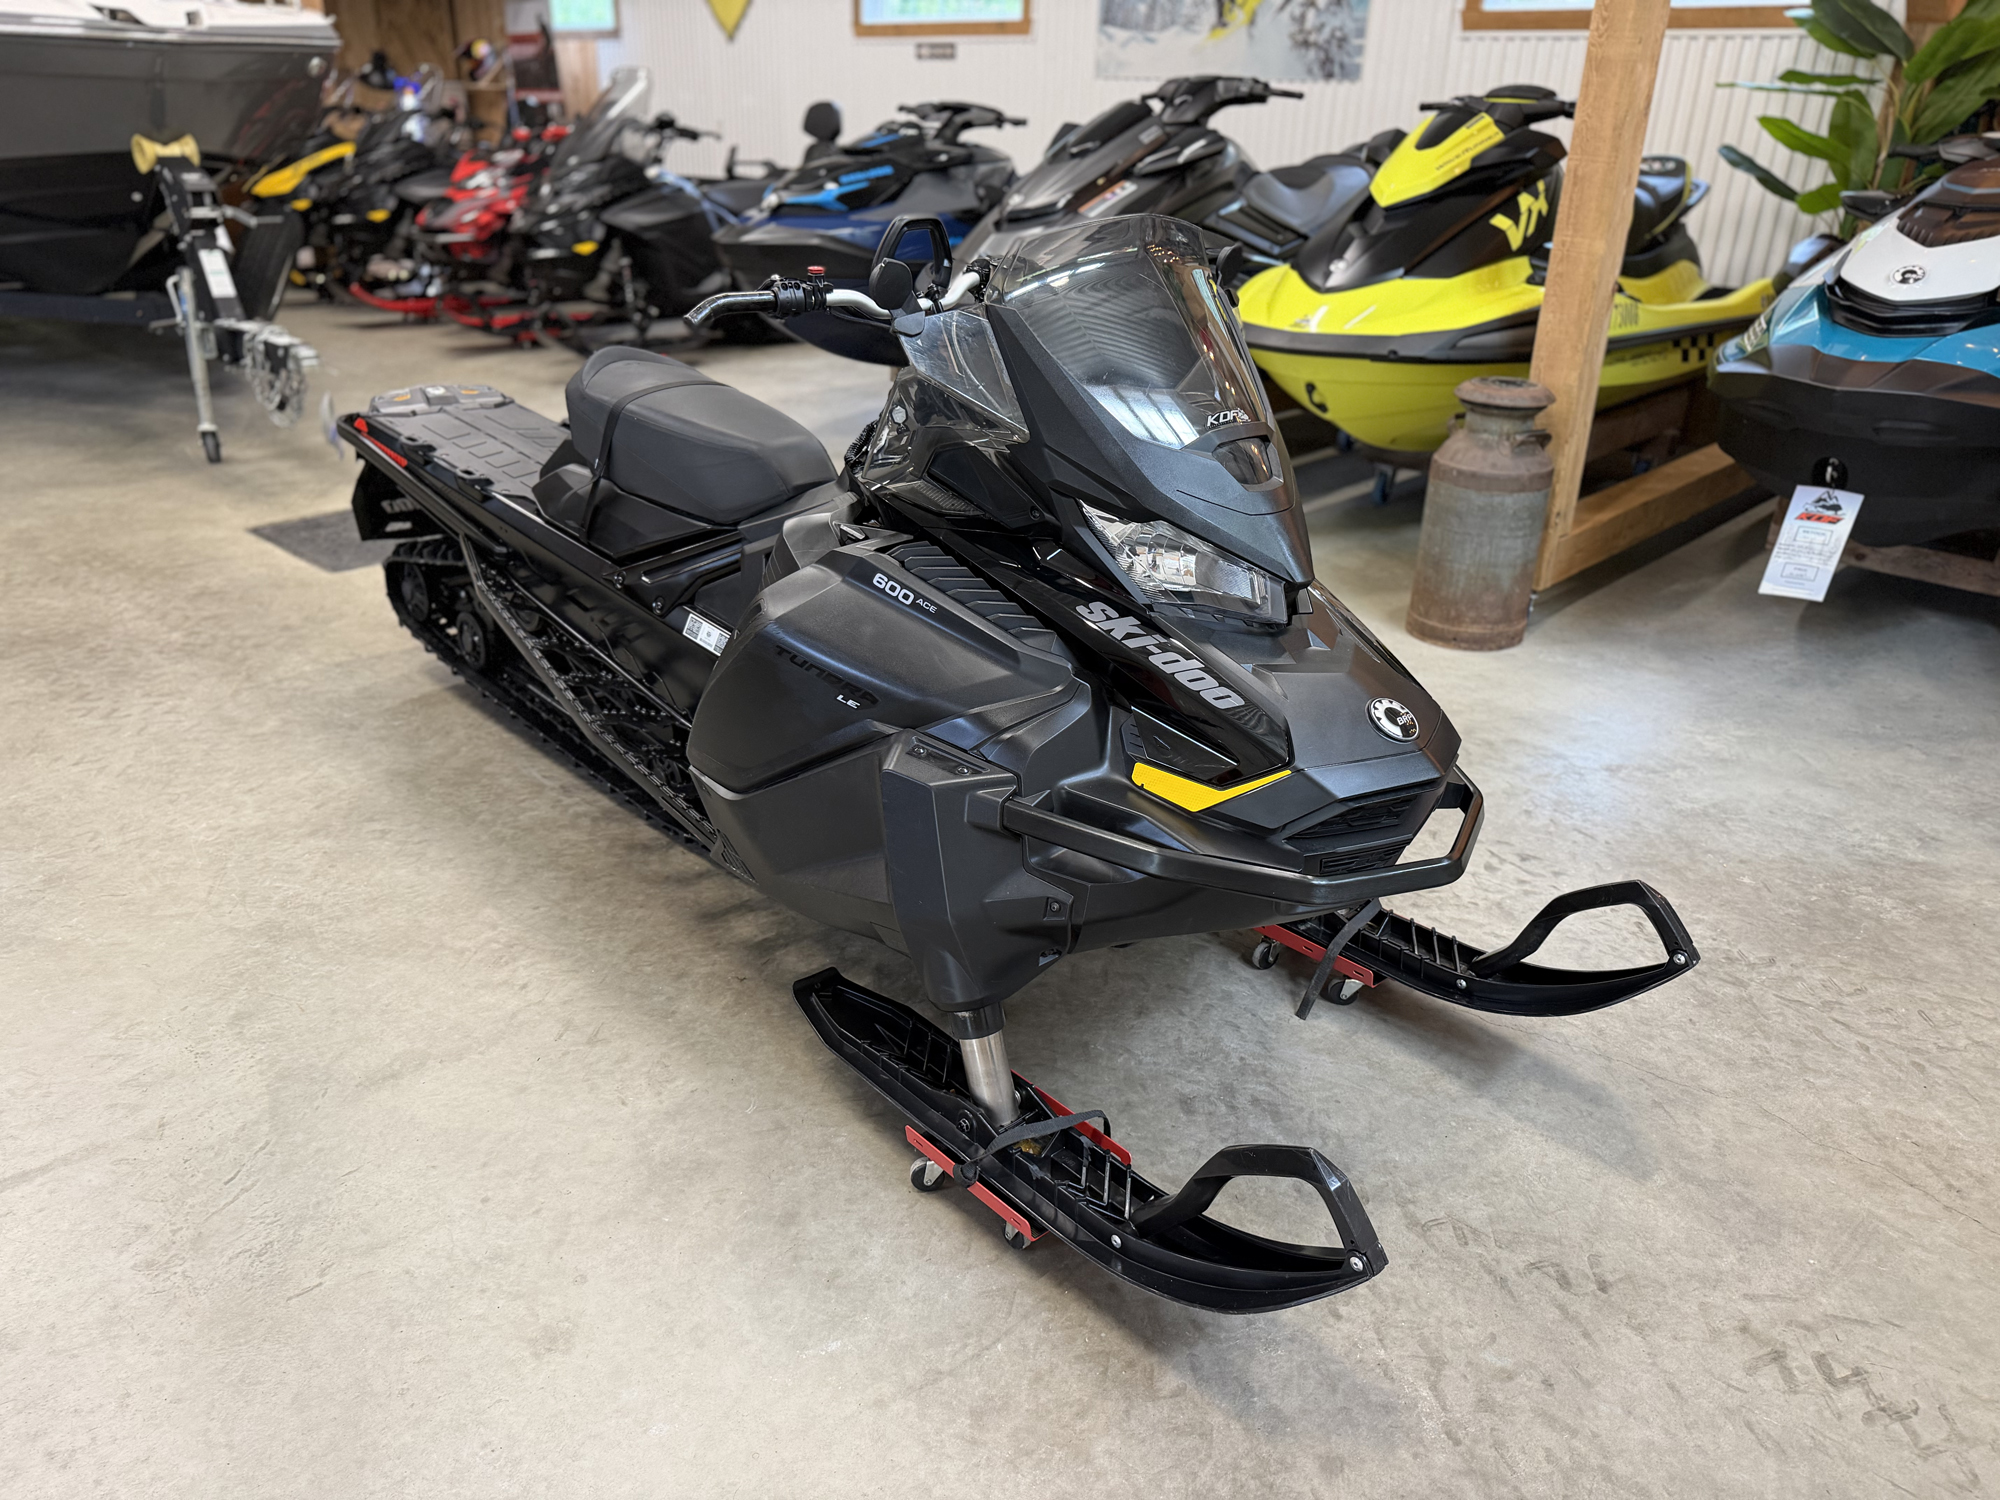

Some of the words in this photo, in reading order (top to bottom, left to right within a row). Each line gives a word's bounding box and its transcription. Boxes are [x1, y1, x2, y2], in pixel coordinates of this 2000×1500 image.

[1489, 179, 1549, 251] VX
[872, 573, 914, 605] 600
[915, 598, 938, 614] ACE
[836, 694, 861, 709] LE
[1397, 713, 1413, 726] BRP
